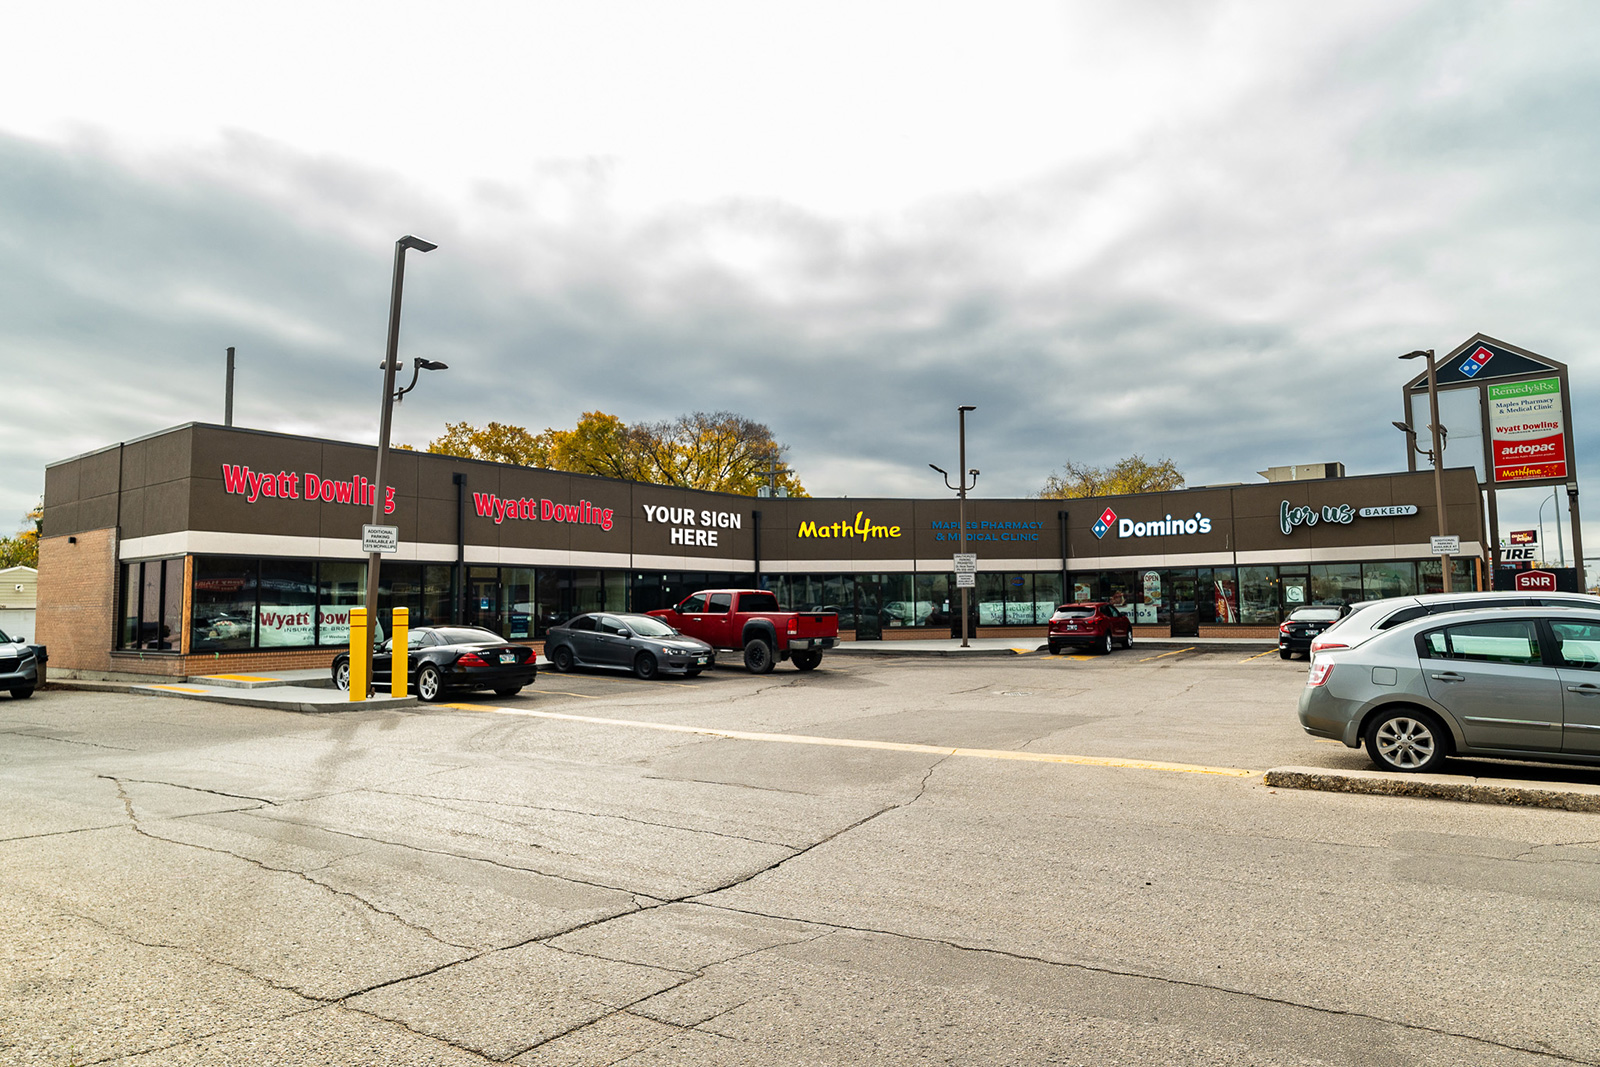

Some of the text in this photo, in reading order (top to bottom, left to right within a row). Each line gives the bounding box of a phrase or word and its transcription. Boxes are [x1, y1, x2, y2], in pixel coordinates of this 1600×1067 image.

[1496, 398, 1554, 409] Maples Pharmacy
[1506, 405, 1532, 413] Medical
[1496, 425, 1520, 434] Wyatt
[1522, 421, 1558, 430] Dowling
[1501, 443, 1555, 455] autopac
[1502, 465, 1542, 477] Math4me
[222, 463, 299, 503] Wyatt
[473, 492, 614, 531] Wyatt Dowling
[643, 504, 741, 529] YOUR SIGN
[1280, 500, 1411, 535] for us BAKERY
[798, 511, 901, 542] Math4me
[981, 521, 1044, 529] PHARMACY
[1118, 512, 1212, 538] Domino's
[670, 527, 718, 547] HERE
[936, 533, 945, 541] &
[1001, 532, 1039, 541] CLINIC
[1521, 577, 1551, 586] SNR
[260, 612, 310, 630] Wyatt
